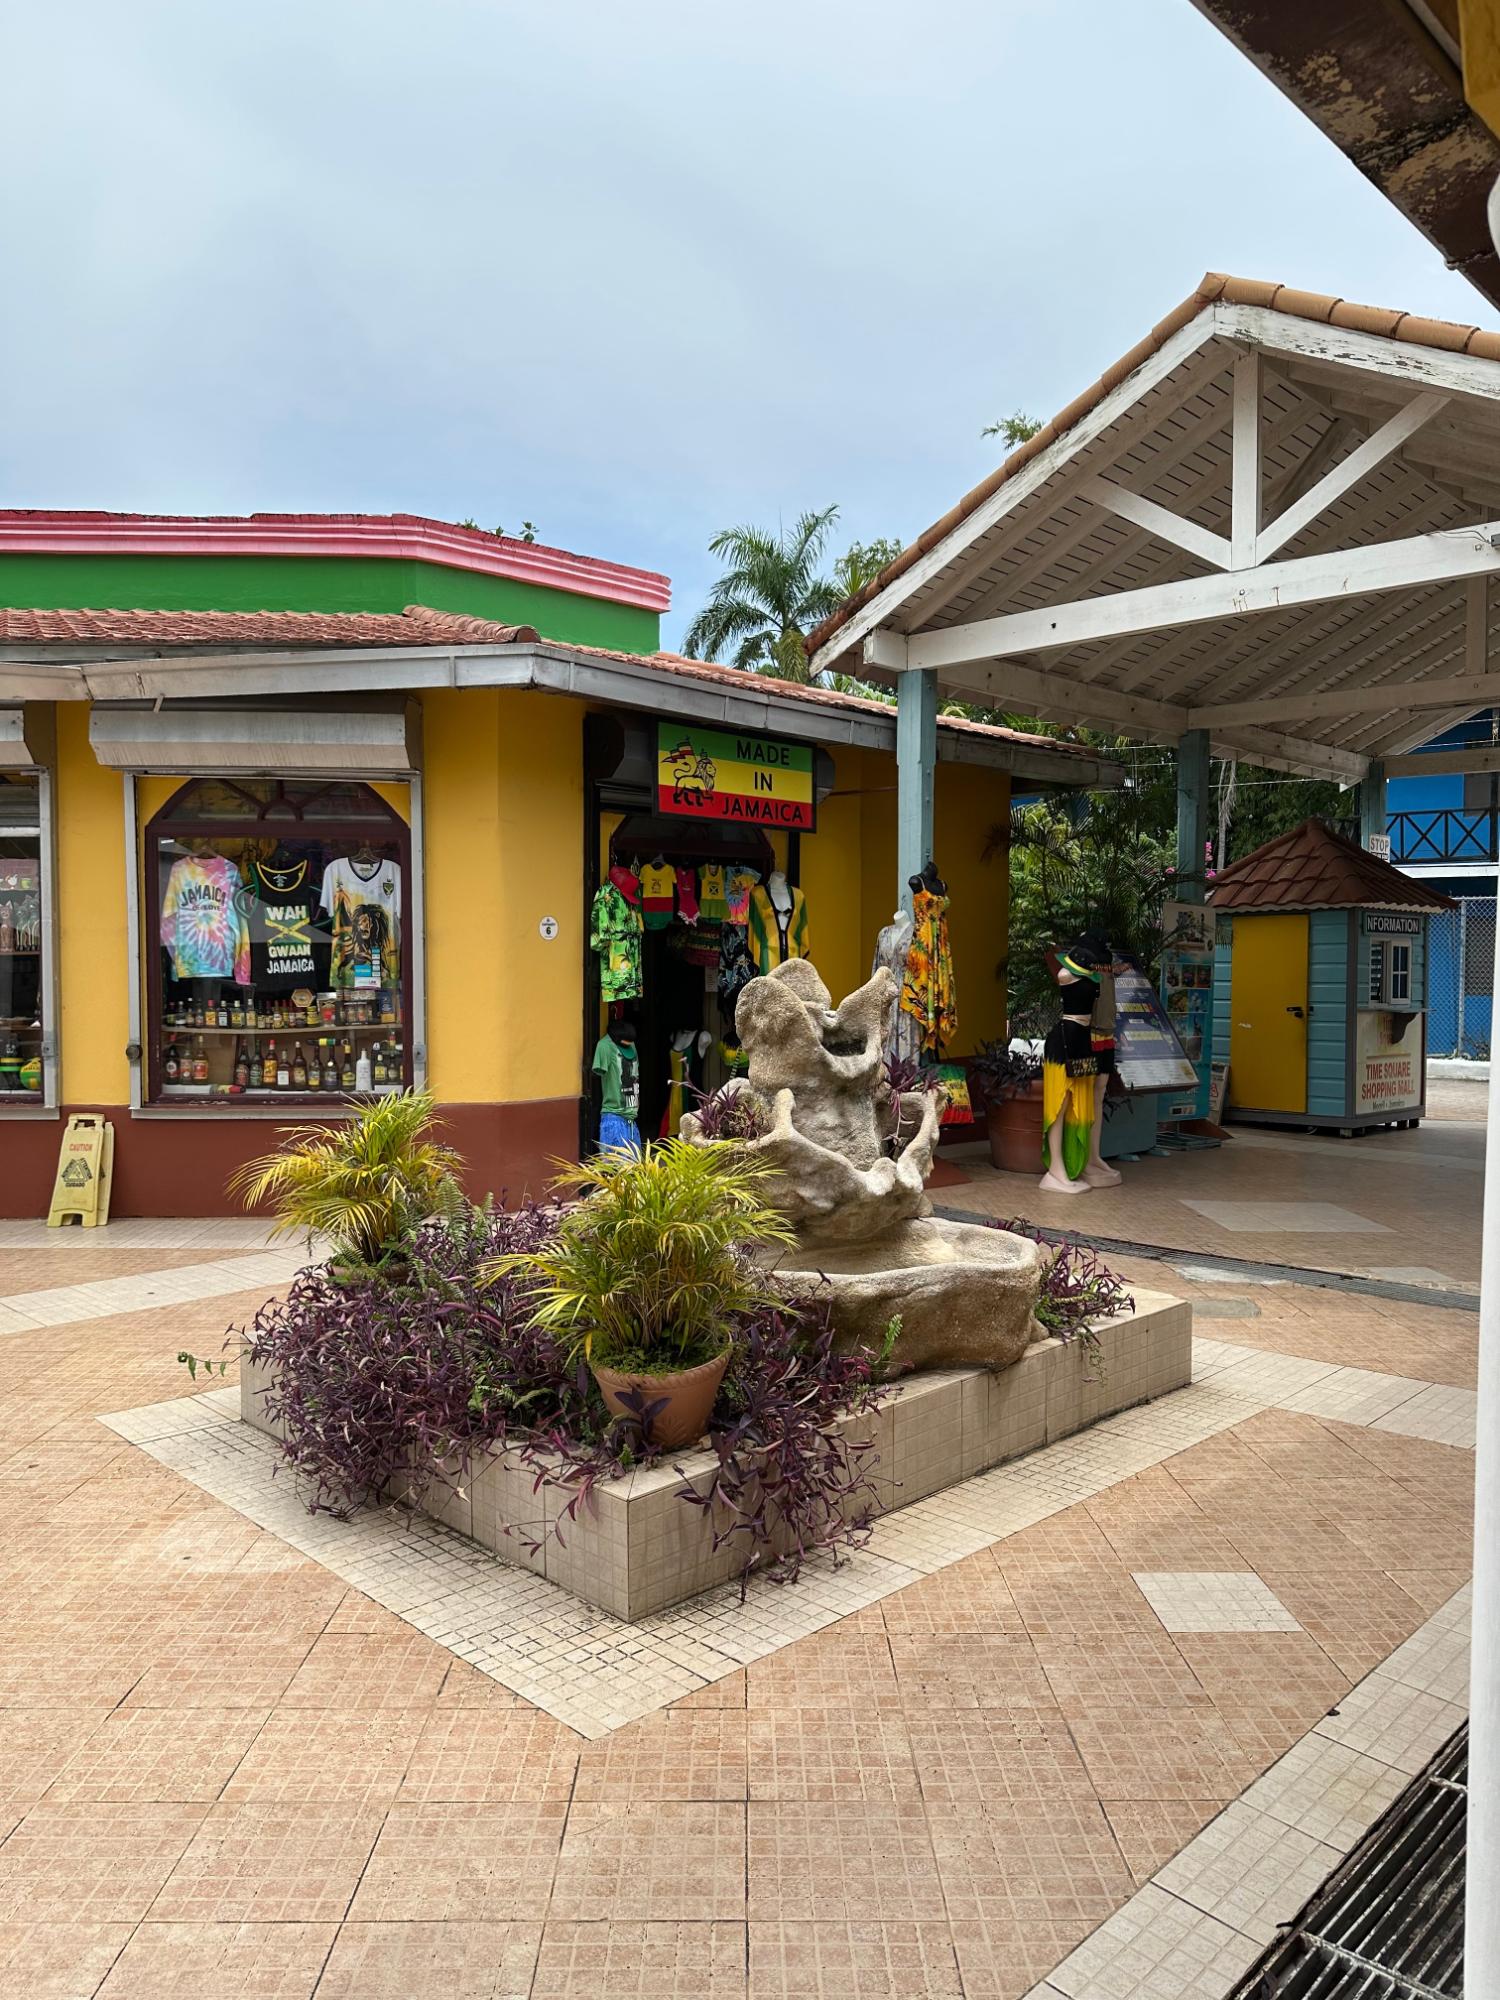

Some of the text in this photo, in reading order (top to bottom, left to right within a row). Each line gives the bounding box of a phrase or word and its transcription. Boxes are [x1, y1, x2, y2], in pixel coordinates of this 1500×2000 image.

[736, 739, 791, 766] MADE
[754, 771, 773, 792] IN
[721, 797, 803, 823] JAMAICA
[1370, 837, 1389, 852] STOP
[266, 905, 307, 921] WAH
[545, 926, 552, 935] 6
[1367, 916, 1419, 933] NFORMATION
[268, 943, 311, 958] GWAAN
[266, 959, 315, 974] JAMAICA
[1365, 1061, 1411, 1080] TIME SQUARE
[1361, 1079, 1415, 1101] SHOPPING MALL
[69, 1143, 93, 1152] CAUTION
